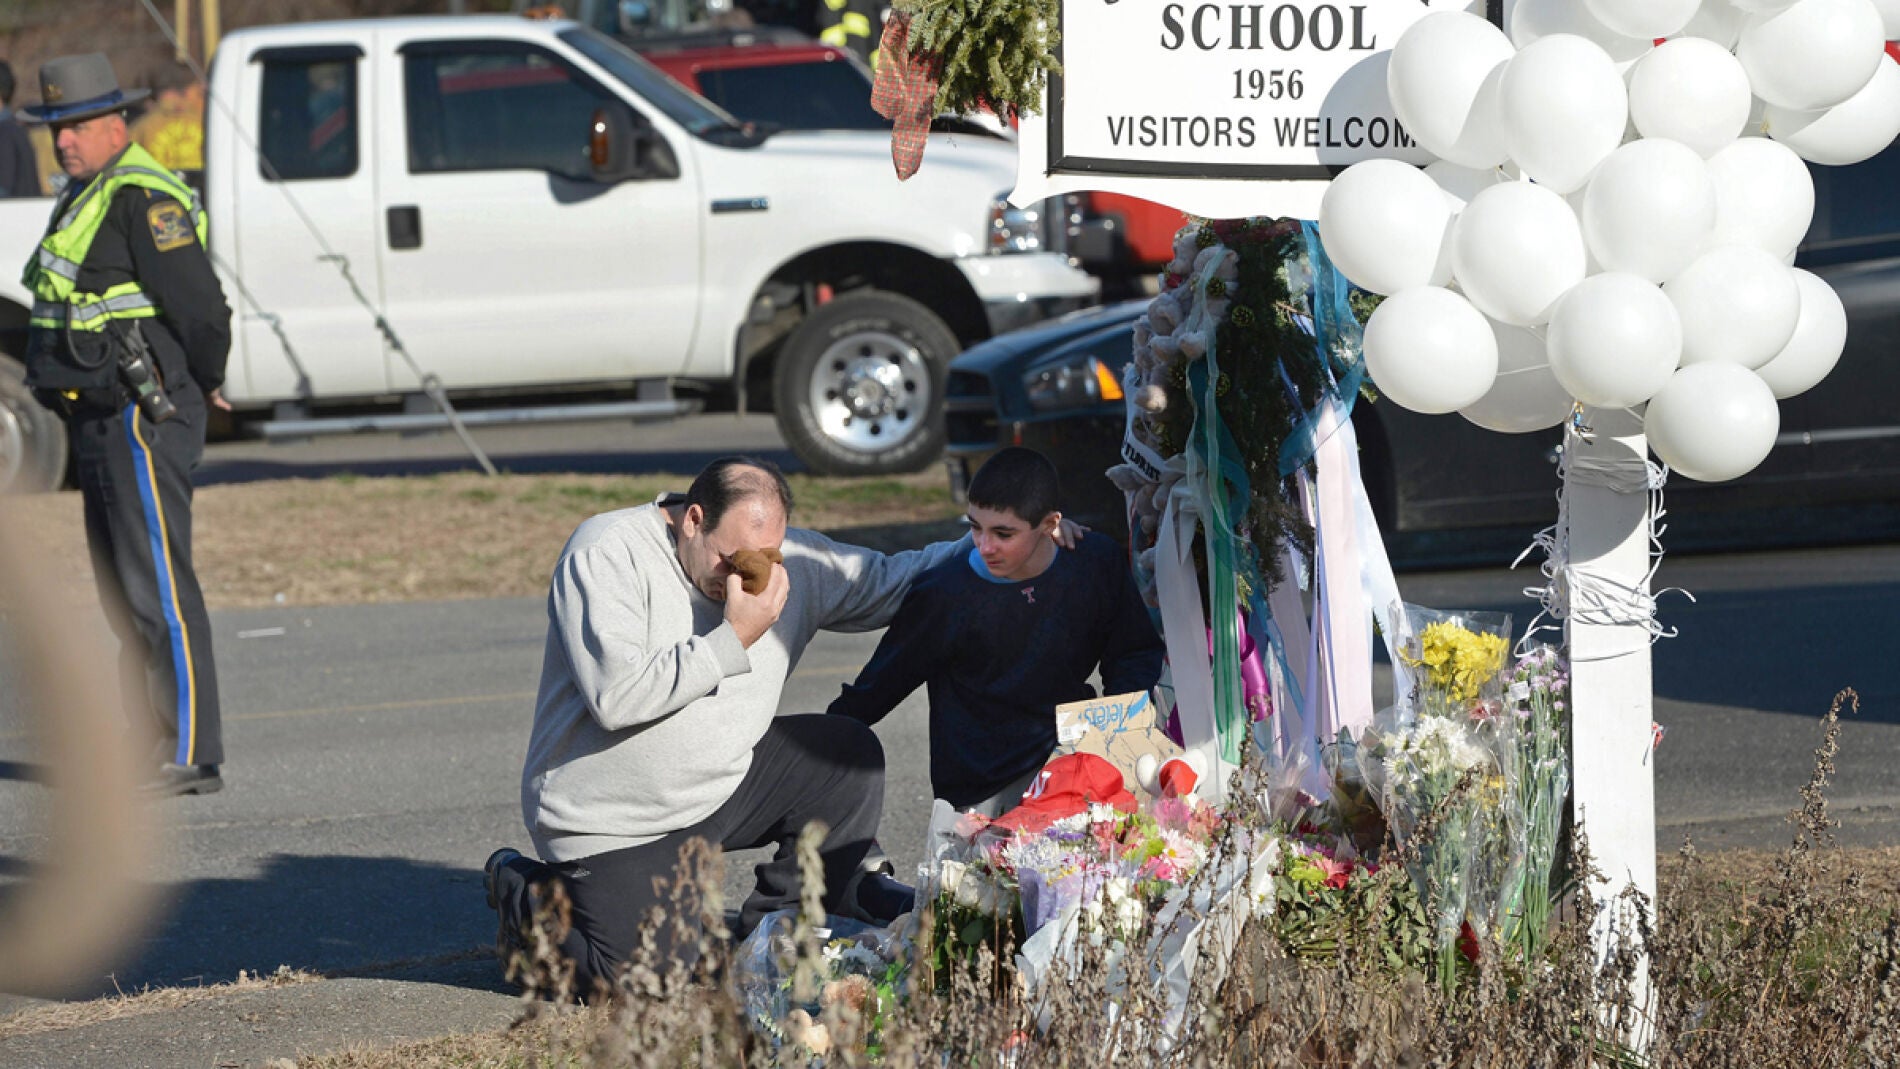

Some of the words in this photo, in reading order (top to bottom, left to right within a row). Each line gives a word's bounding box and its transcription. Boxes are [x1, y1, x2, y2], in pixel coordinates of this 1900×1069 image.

[1161, 3, 1377, 51] SCHOOL
[1233, 69, 1304, 100] 1956
[1107, 116, 1255, 148] VISITORS
